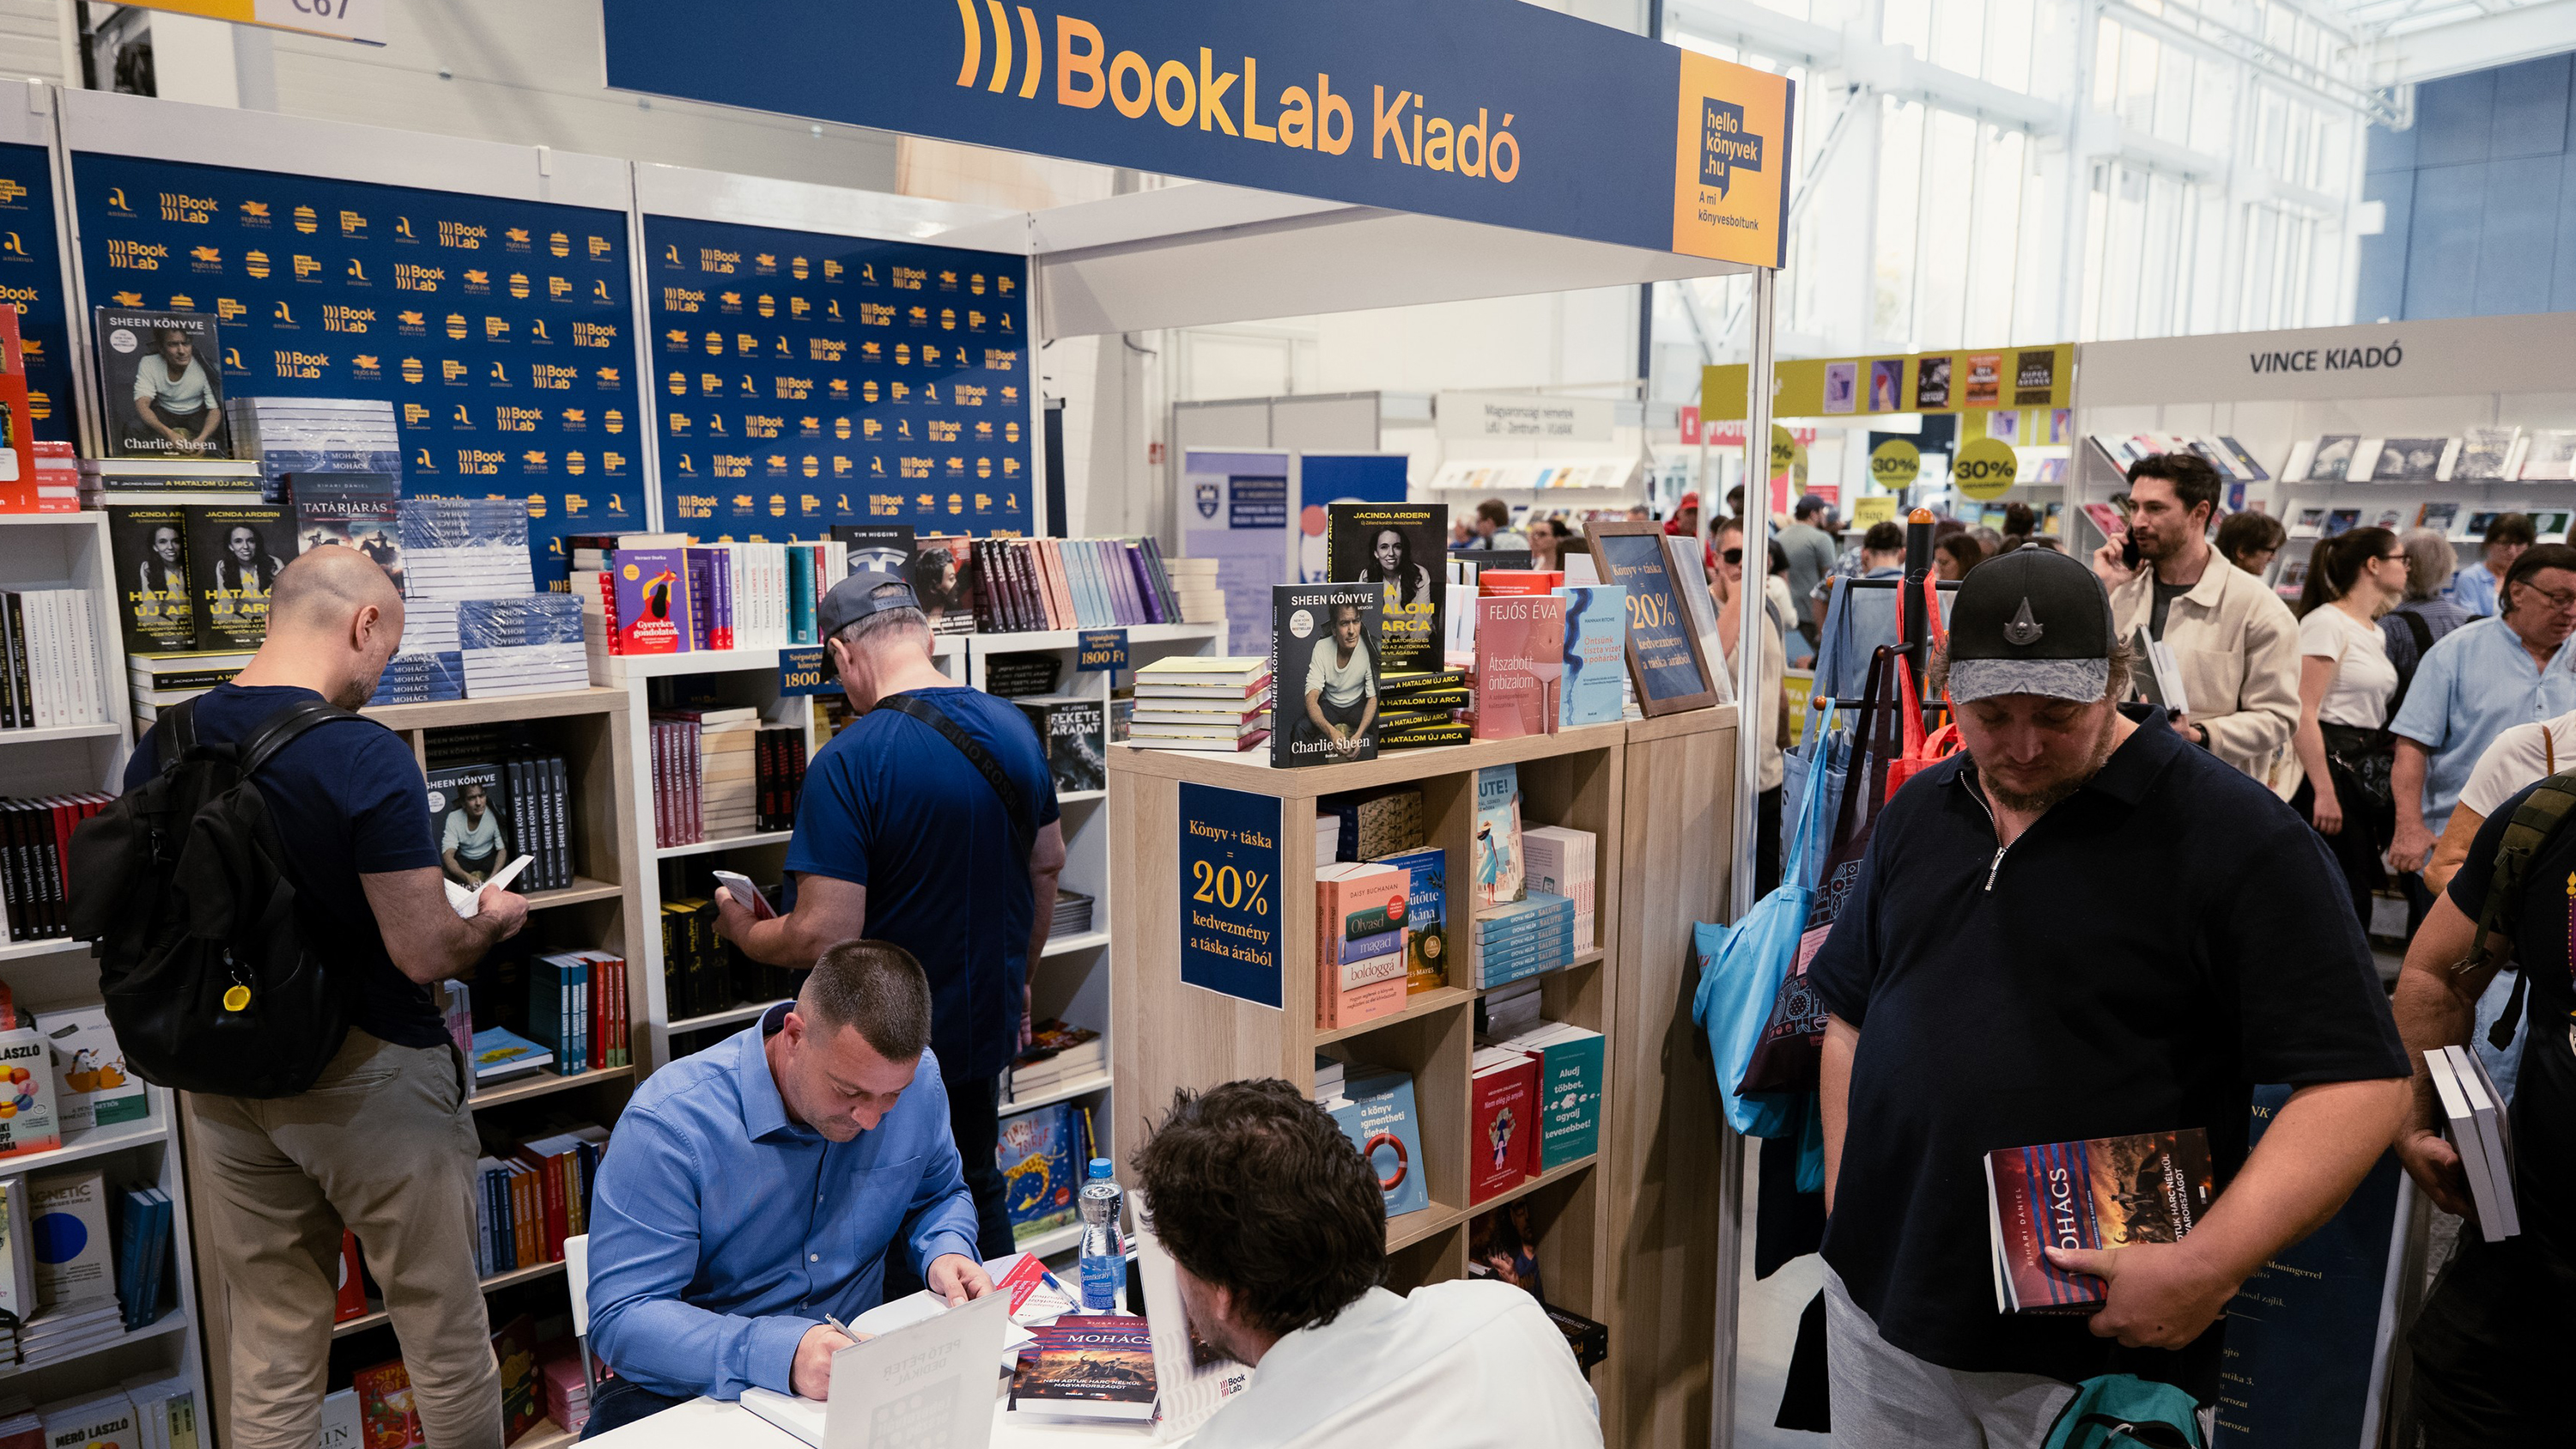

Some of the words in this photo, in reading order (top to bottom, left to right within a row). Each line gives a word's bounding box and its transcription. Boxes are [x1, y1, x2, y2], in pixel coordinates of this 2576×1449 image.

[1056, 14, 1354, 155] BookLab
[1373, 83, 1521, 183] Kiadó
[1708, 108, 1737, 133] hello
[1706, 131, 1758, 161] könyvek
[1705, 155, 1724, 177] .hu
[179, 194, 219, 211] Book
[1699, 192, 1704, 203] A
[1707, 192, 1716, 205] mi
[179, 209, 209, 223] Lab
[1698, 209, 1759, 230] könyvesboltunk
[454, 222, 488, 238] Book
[455, 236, 479, 250] Lab
[714, 250, 741, 263] Book
[411, 265, 445, 280] Book
[715, 261, 734, 274] Lab
[412, 278, 437, 292] Lab
[110, 317, 150, 326] SHEEN
[154, 318, 204, 329] KÖNYVE
[293, 352, 330, 366] Book
[2251, 350, 2318, 374] VINCE
[2324, 339, 2403, 371] KIADÓ
[294, 364, 320, 379] Lab
[125, 438, 173, 449] Charlie
[176, 439, 216, 450] Sheen
[474, 450, 505, 463] Book
[475, 461, 498, 475] Lab
[1872, 457, 1917, 472] 30%
[1956, 460, 2014, 478] 30%
[303, 501, 387, 514] TATÁRJÁRÁS
[1612, 564, 1636, 577] Könyv
[1643, 562, 1662, 574] táska
[1384, 585, 1398, 596] A
[1291, 595, 1328, 606] SHEEN
[1331, 592, 1373, 605] KÖNYVE
[1490, 602, 1528, 619] FEJŐS
[1533, 600, 1558, 619] ÉVA
[1625, 593, 1675, 629] 20%
[634, 627, 679, 638] gondolatok
[637, 620, 675, 630] Gyerekes
[1382, 621, 1431, 631] ARCA
[1584, 636, 1613, 645] Öntsünk
[1637, 635, 1682, 650] kedvezmény
[1082, 652, 1109, 664] 1800
[1113, 651, 1124, 662] Ft
[1584, 646, 1603, 654] tiszta
[1489, 653, 1534, 672] Átszabott
[1589, 653, 1620, 665] pohárba!
[1648, 654, 1667, 668] táska
[1668, 652, 1691, 666] árából
[1402, 679, 1432, 687] HATALOM
[1489, 674, 1534, 691] önbizalom
[1051, 711, 1101, 724] FEKETE
[1291, 739, 1334, 754] Charlie
[1336, 737, 1370, 750] Sheen
[426, 780, 456, 790] SHEEN
[458, 774, 495, 786] KÖNYVE
[981, 762, 1017, 810] ROSSI
[1189, 819, 1228, 841] Könyv
[1240, 830, 1272, 849] táska
[1193, 860, 1269, 916] 20%
[1367, 884, 1398, 895] BUCHANAN
[1538, 904, 1561, 916] SALUTE!
[1193, 910, 1270, 945] kedvezmény
[1352, 914, 1384, 933] Olvasd
[1191, 939, 1197, 948] a
[1200, 937, 1230, 958] táska
[1231, 944, 1273, 967] árából
[1360, 935, 1391, 954] magad
[1351, 959, 1394, 981] boldoggá
[0, 1043, 40, 1061] LÁSZLÓ
[1559, 1066, 1580, 1078] Aludj
[1554, 1081, 1583, 1093] többet,
[1377, 1093, 1394, 1101] Rajan
[1496, 1097, 1505, 1106] elég
[1511, 1090, 1524, 1101] anyák
[1368, 1105, 1392, 1116] könyv
[1556, 1108, 1580, 1123] agyalj
[1364, 1126, 1389, 1138] életed
[1546, 1119, 1590, 1140] kevesebbet!
[2161, 1154, 2175, 1190] NÉLKÜL
[2016, 1188, 2025, 1224] DÁNIEL
[2167, 1190, 2178, 1215] HARC
[2020, 1230, 2034, 1266] BIHARI
[1081, 1270, 1111, 1283] Szentkirályi
[2267, 1260, 2322, 1280] Moningerrel
[2262, 1296, 2287, 1307] zajlik.
[1067, 1333, 1151, 1344] MOHÁCS
[1228, 1373, 1245, 1385] Book
[1229, 1384, 1242, 1394] Lab
[55, 1428, 85, 1447] MÉRŐ
[88, 1417, 128, 1439] LÁSZLÓ
